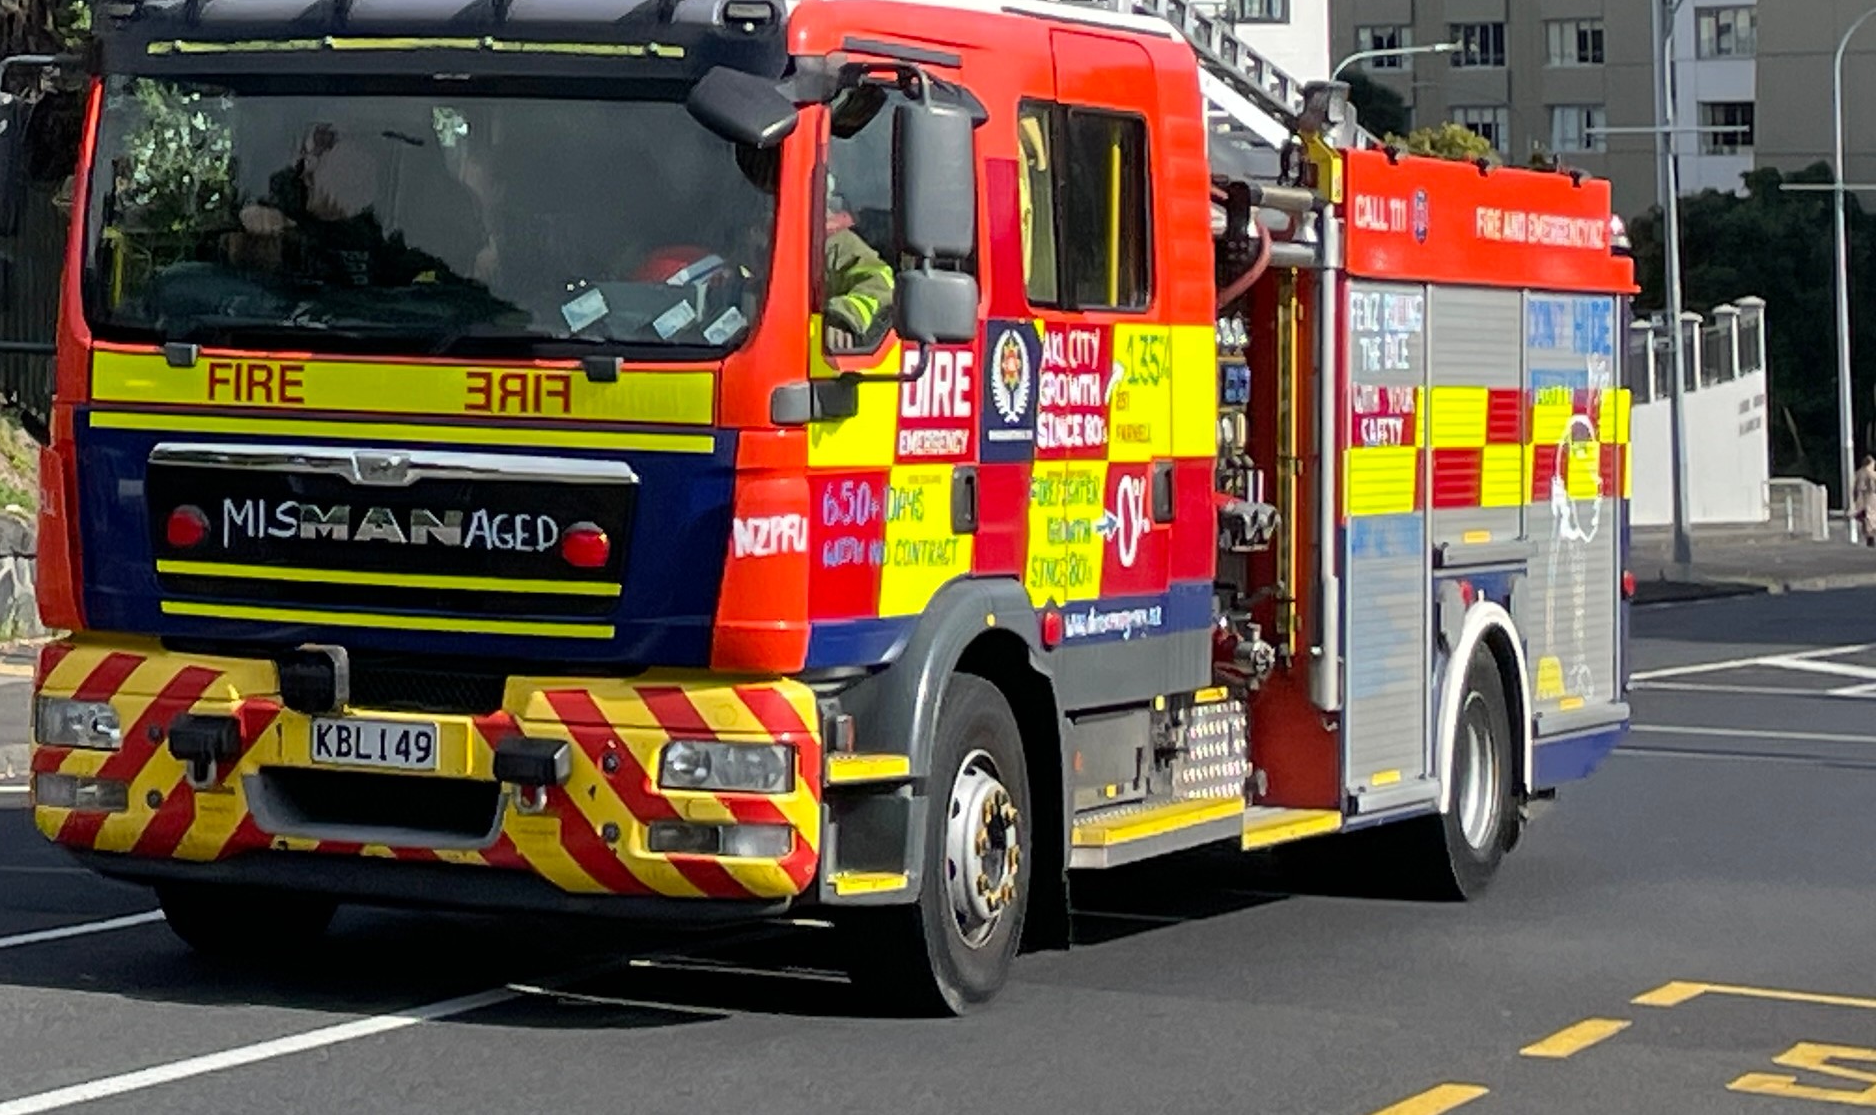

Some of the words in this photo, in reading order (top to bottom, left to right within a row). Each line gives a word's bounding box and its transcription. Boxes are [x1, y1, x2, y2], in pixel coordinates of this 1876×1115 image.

[1354, 195, 1388, 231] CALL
[1476, 206, 1501, 240] FIRE
[1068, 327, 1101, 369] CITY
[207, 363, 305, 404] FIRE
[1036, 412, 1084, 449] SINCE
[733, 514, 808, 558] NZPFU
[893, 537, 960, 567] CONTRACT
